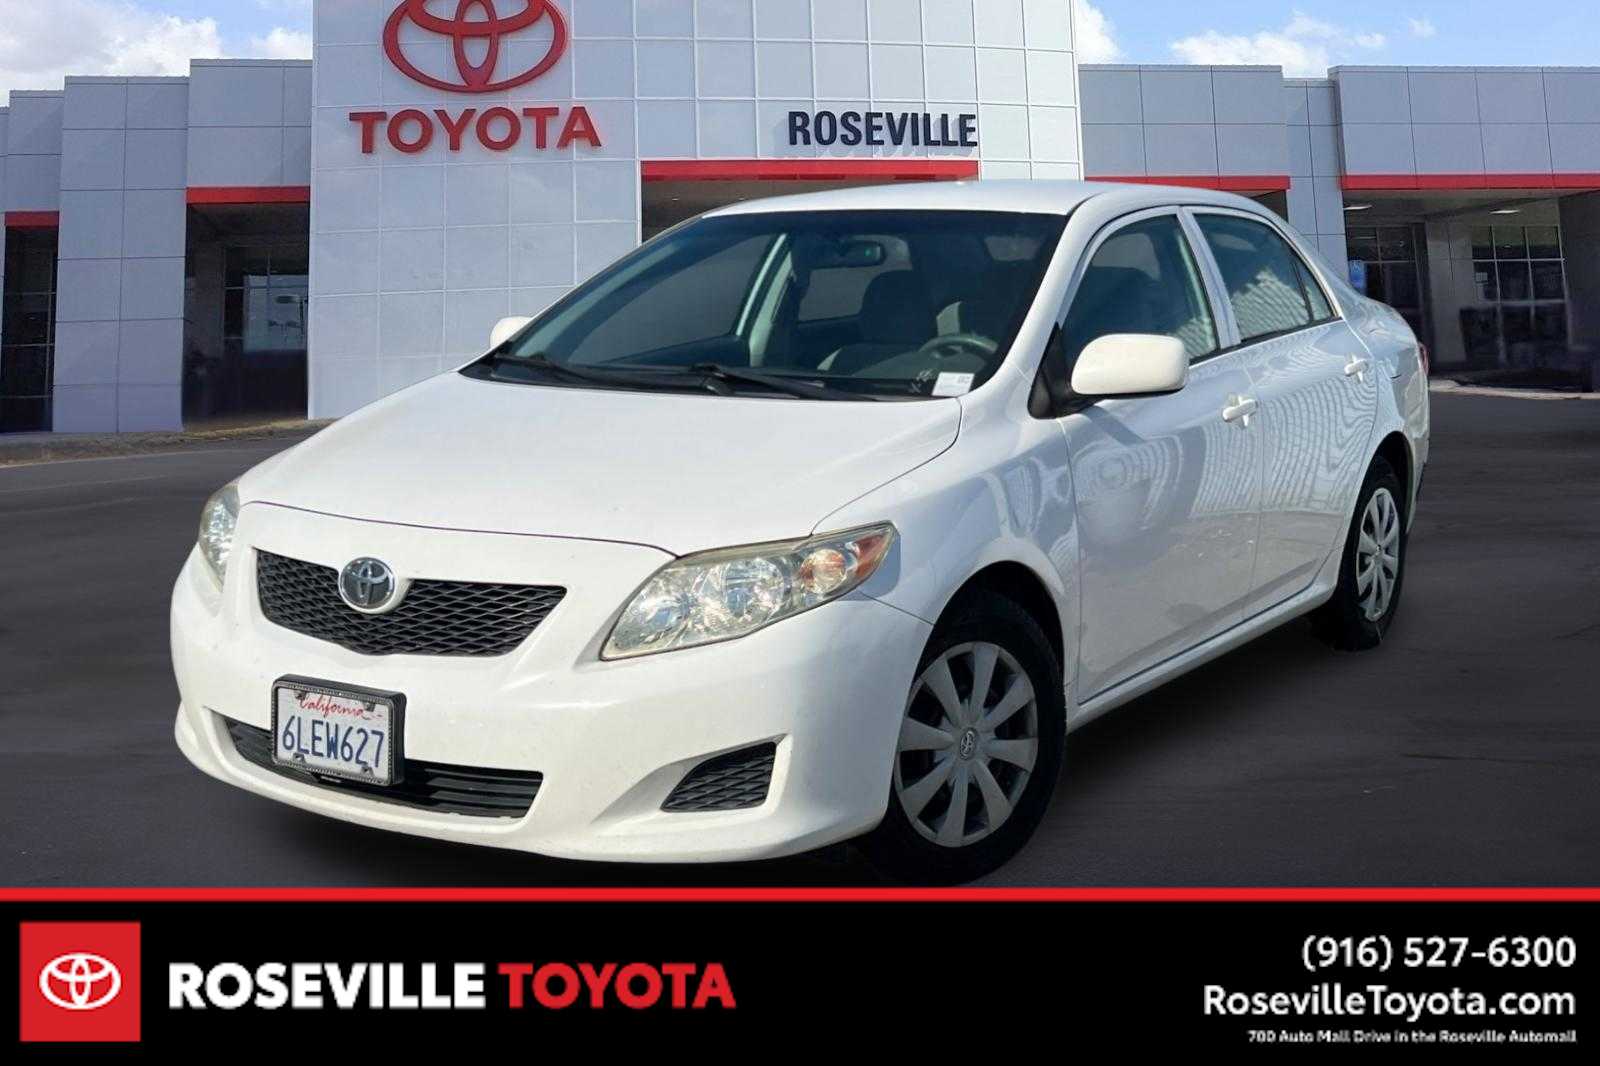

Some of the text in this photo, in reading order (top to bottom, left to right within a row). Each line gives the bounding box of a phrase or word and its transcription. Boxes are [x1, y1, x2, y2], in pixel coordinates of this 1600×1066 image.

[349, 105, 602, 154] TOYOTA
[788, 111, 978, 147] ROSEVILLE
[282, 715, 385, 768] 6LEW627
